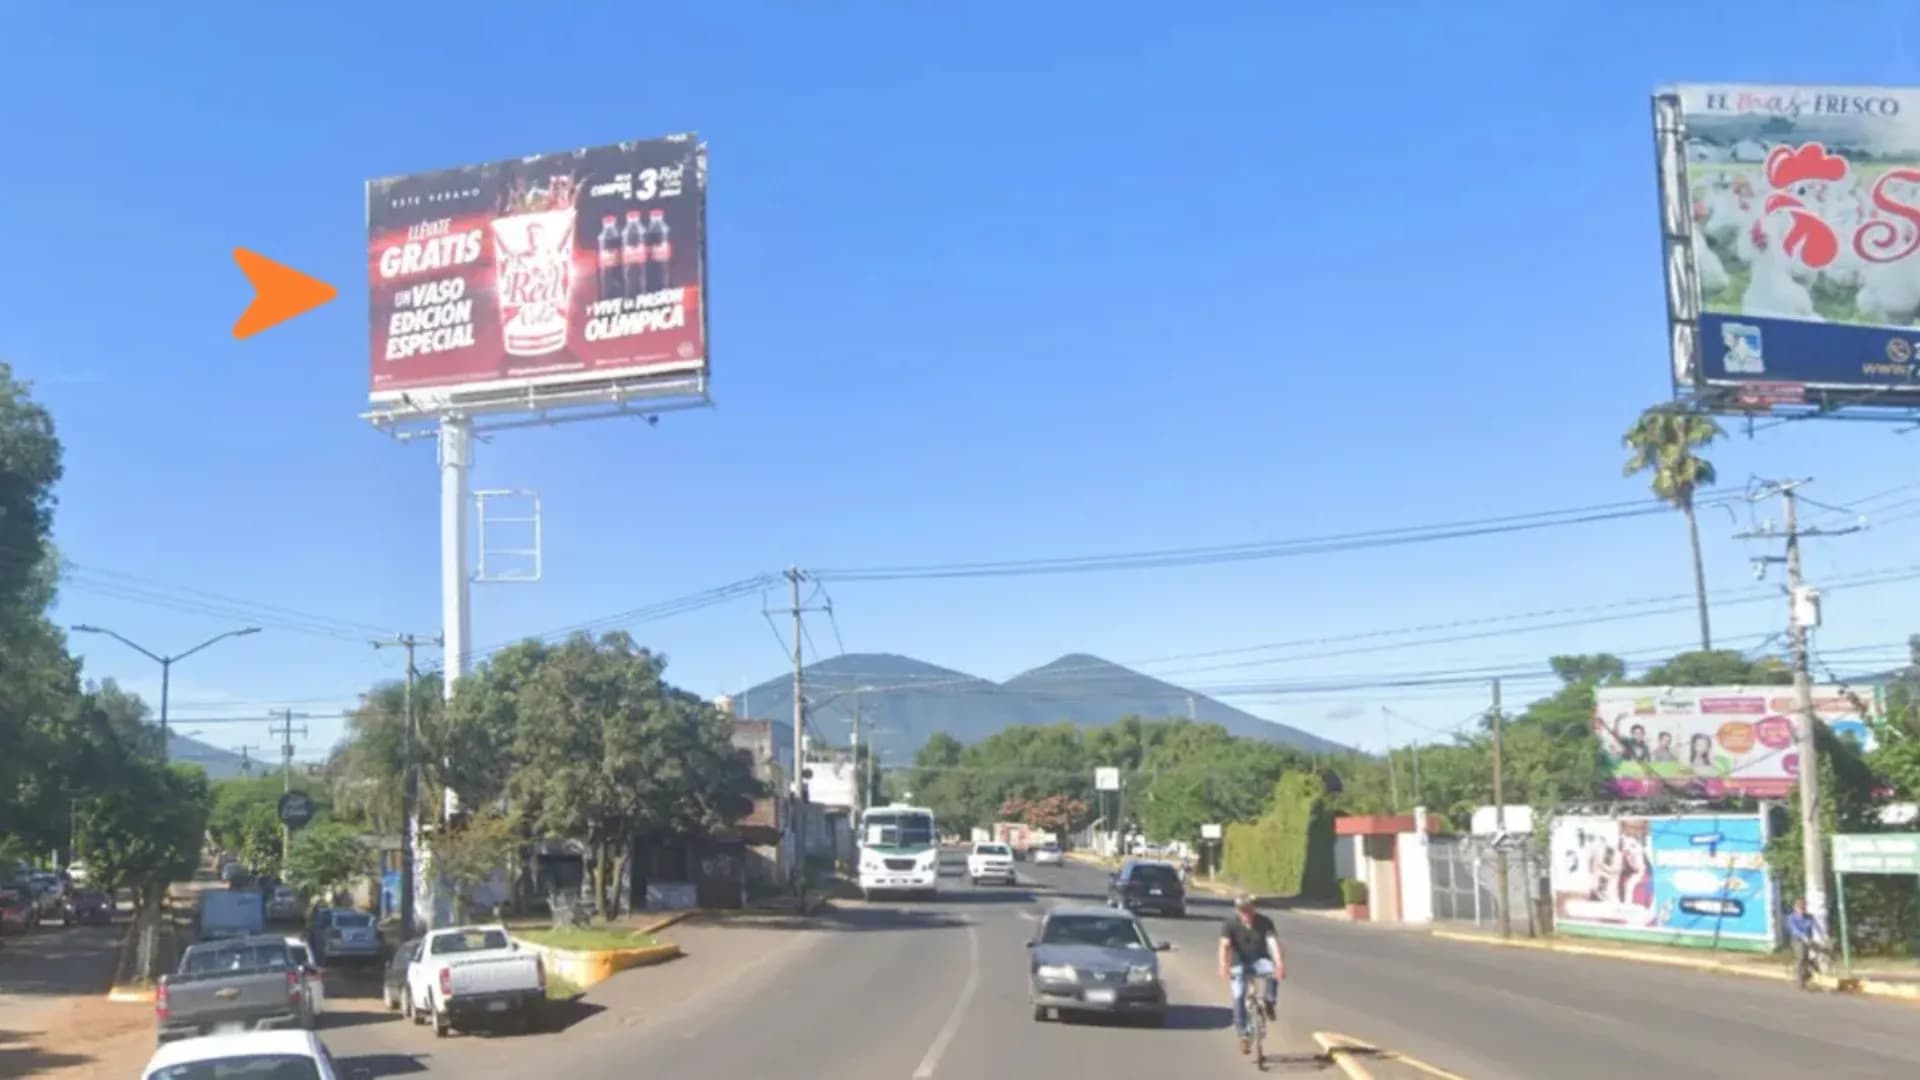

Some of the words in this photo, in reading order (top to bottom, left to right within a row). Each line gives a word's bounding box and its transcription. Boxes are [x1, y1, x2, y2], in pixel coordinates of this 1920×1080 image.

[1706, 93, 1730, 111] EL
[1814, 94, 1900, 117] FRESCO
[636, 168, 658, 201] 3
[380, 229, 483, 278] GRATIS
[412, 276, 465, 308] VASO
[385, 323, 476, 360] ESPECIAL
